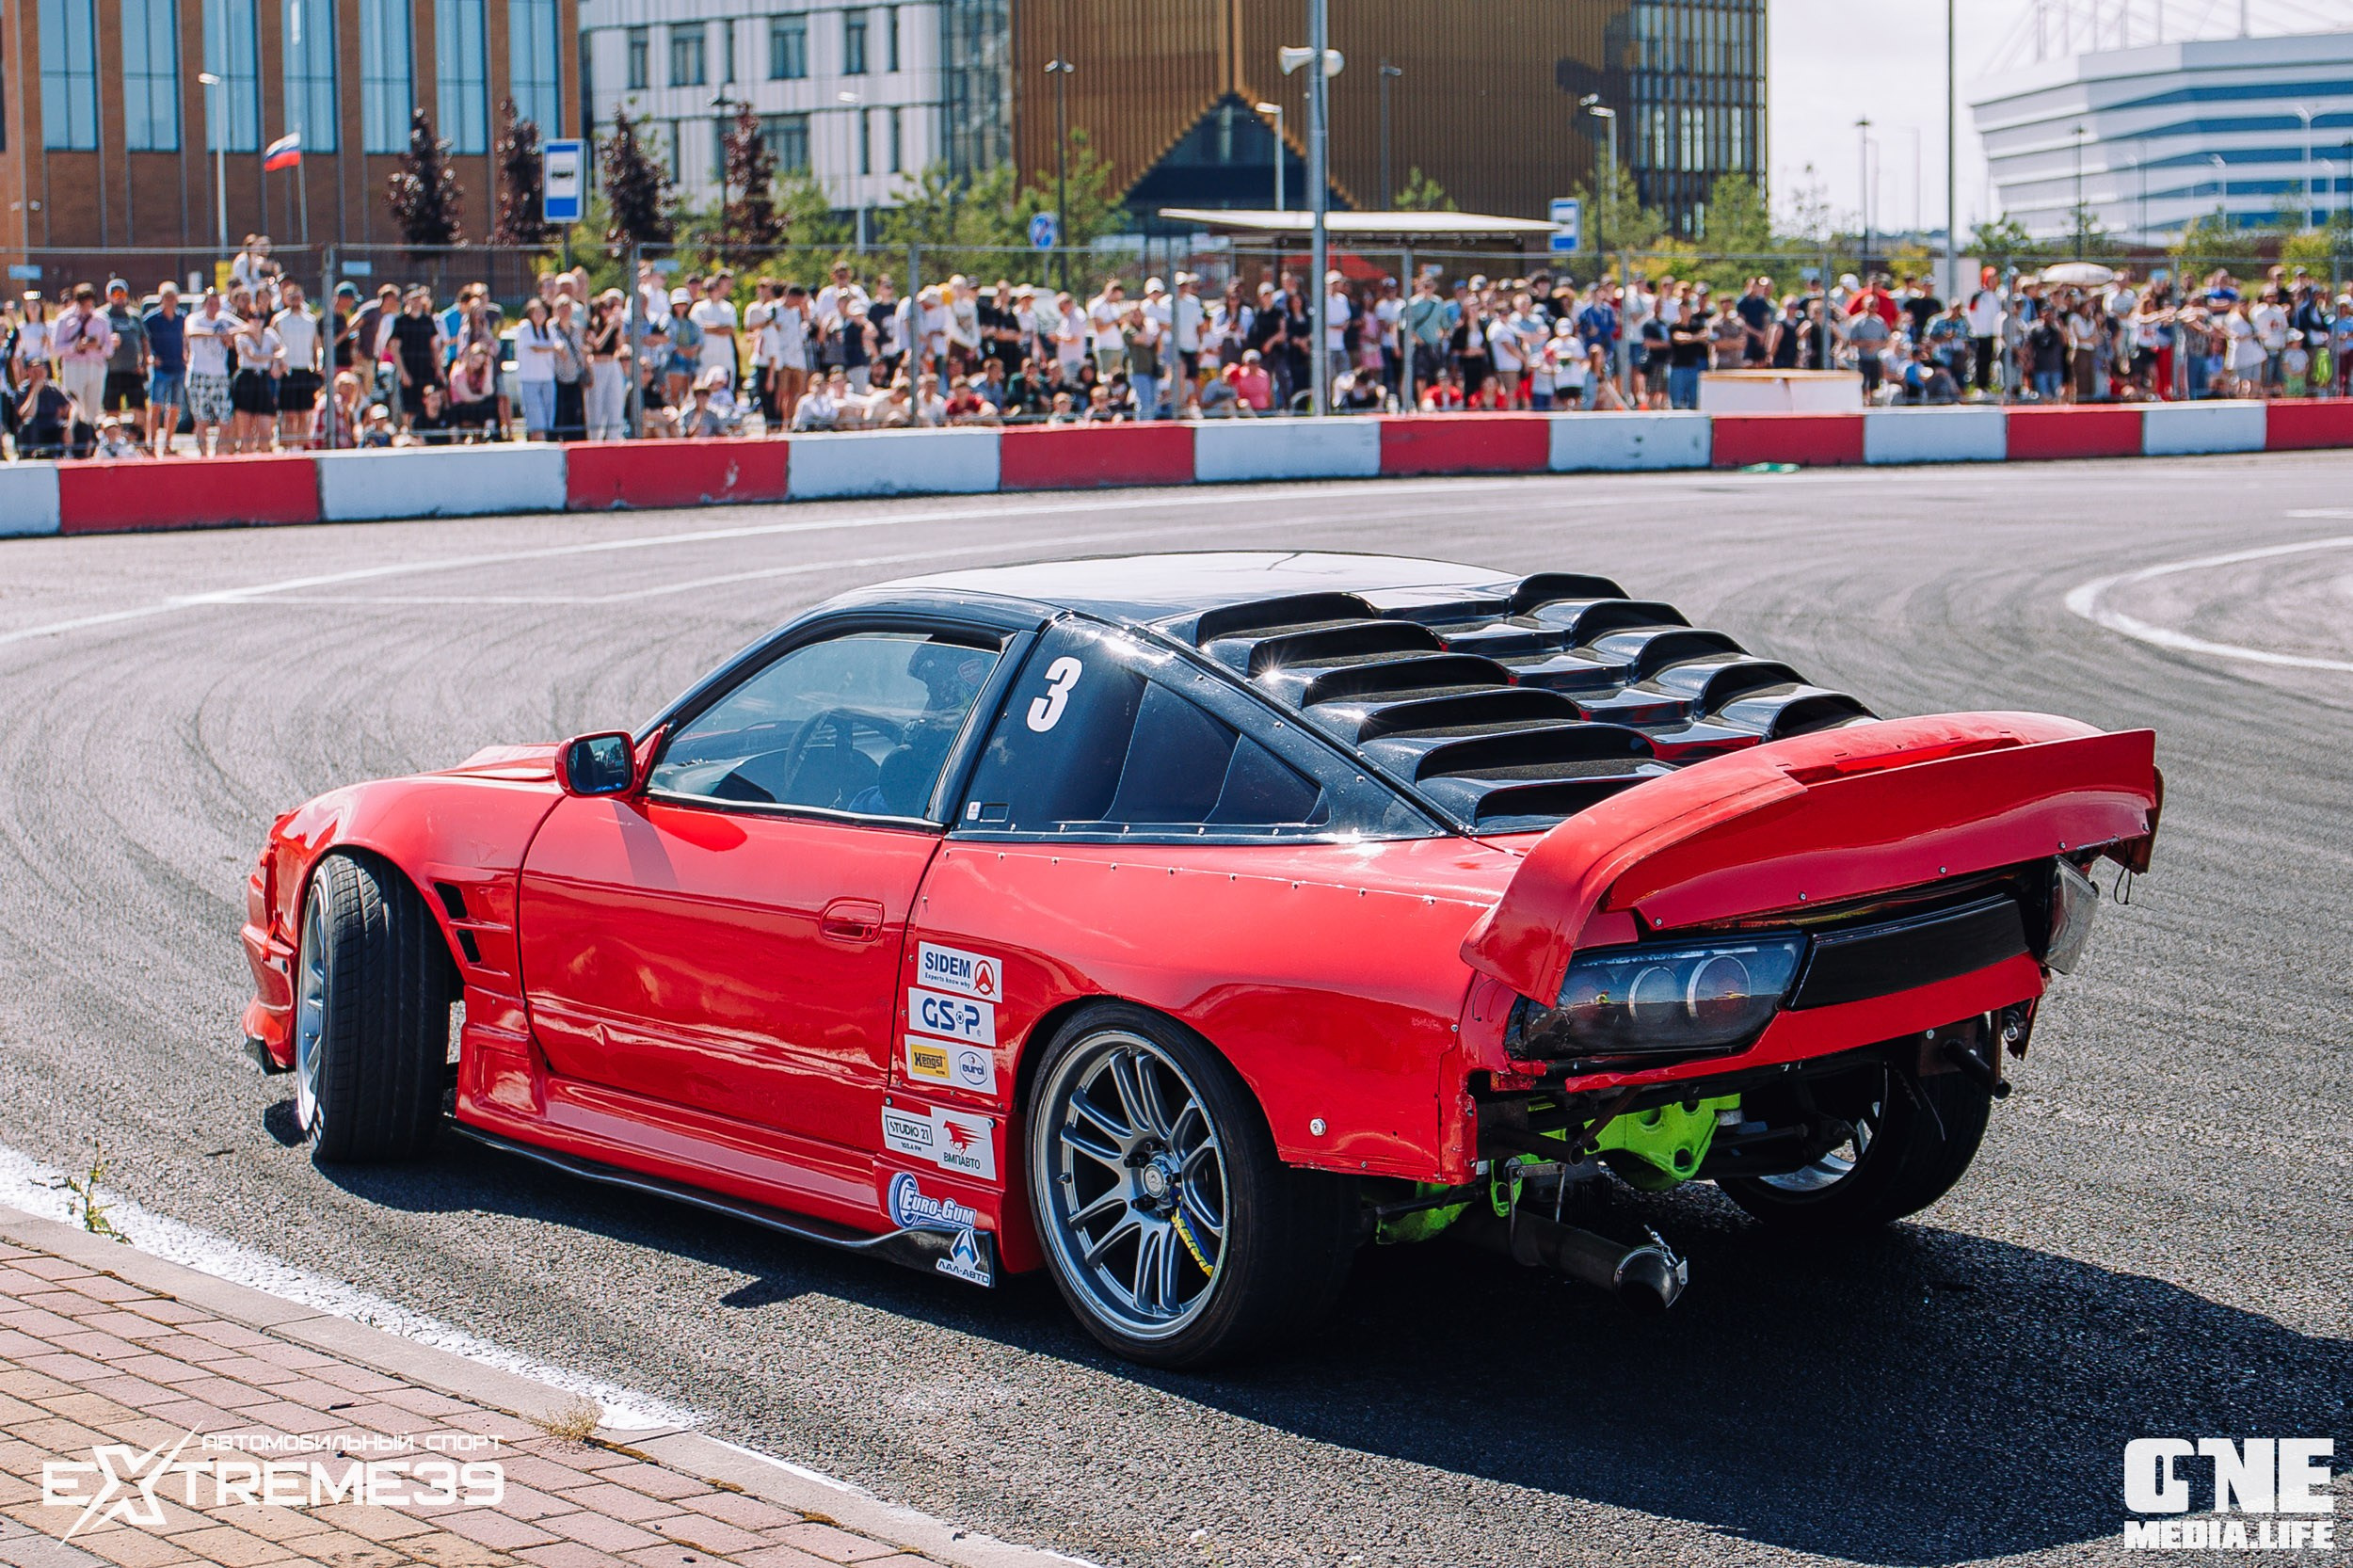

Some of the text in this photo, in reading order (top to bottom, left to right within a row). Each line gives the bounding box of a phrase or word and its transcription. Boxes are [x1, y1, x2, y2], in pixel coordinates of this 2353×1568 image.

[1026, 656, 1083, 732] 3
[924, 951, 971, 979] SIDEM
[924, 971, 970, 989] Experts know why
[914, 1051, 944, 1069] Hengst
[962, 1064, 985, 1076] eurol
[889, 1121, 930, 1141] STUDIO 21
[943, 1151, 981, 1170] ВМПАВТО
